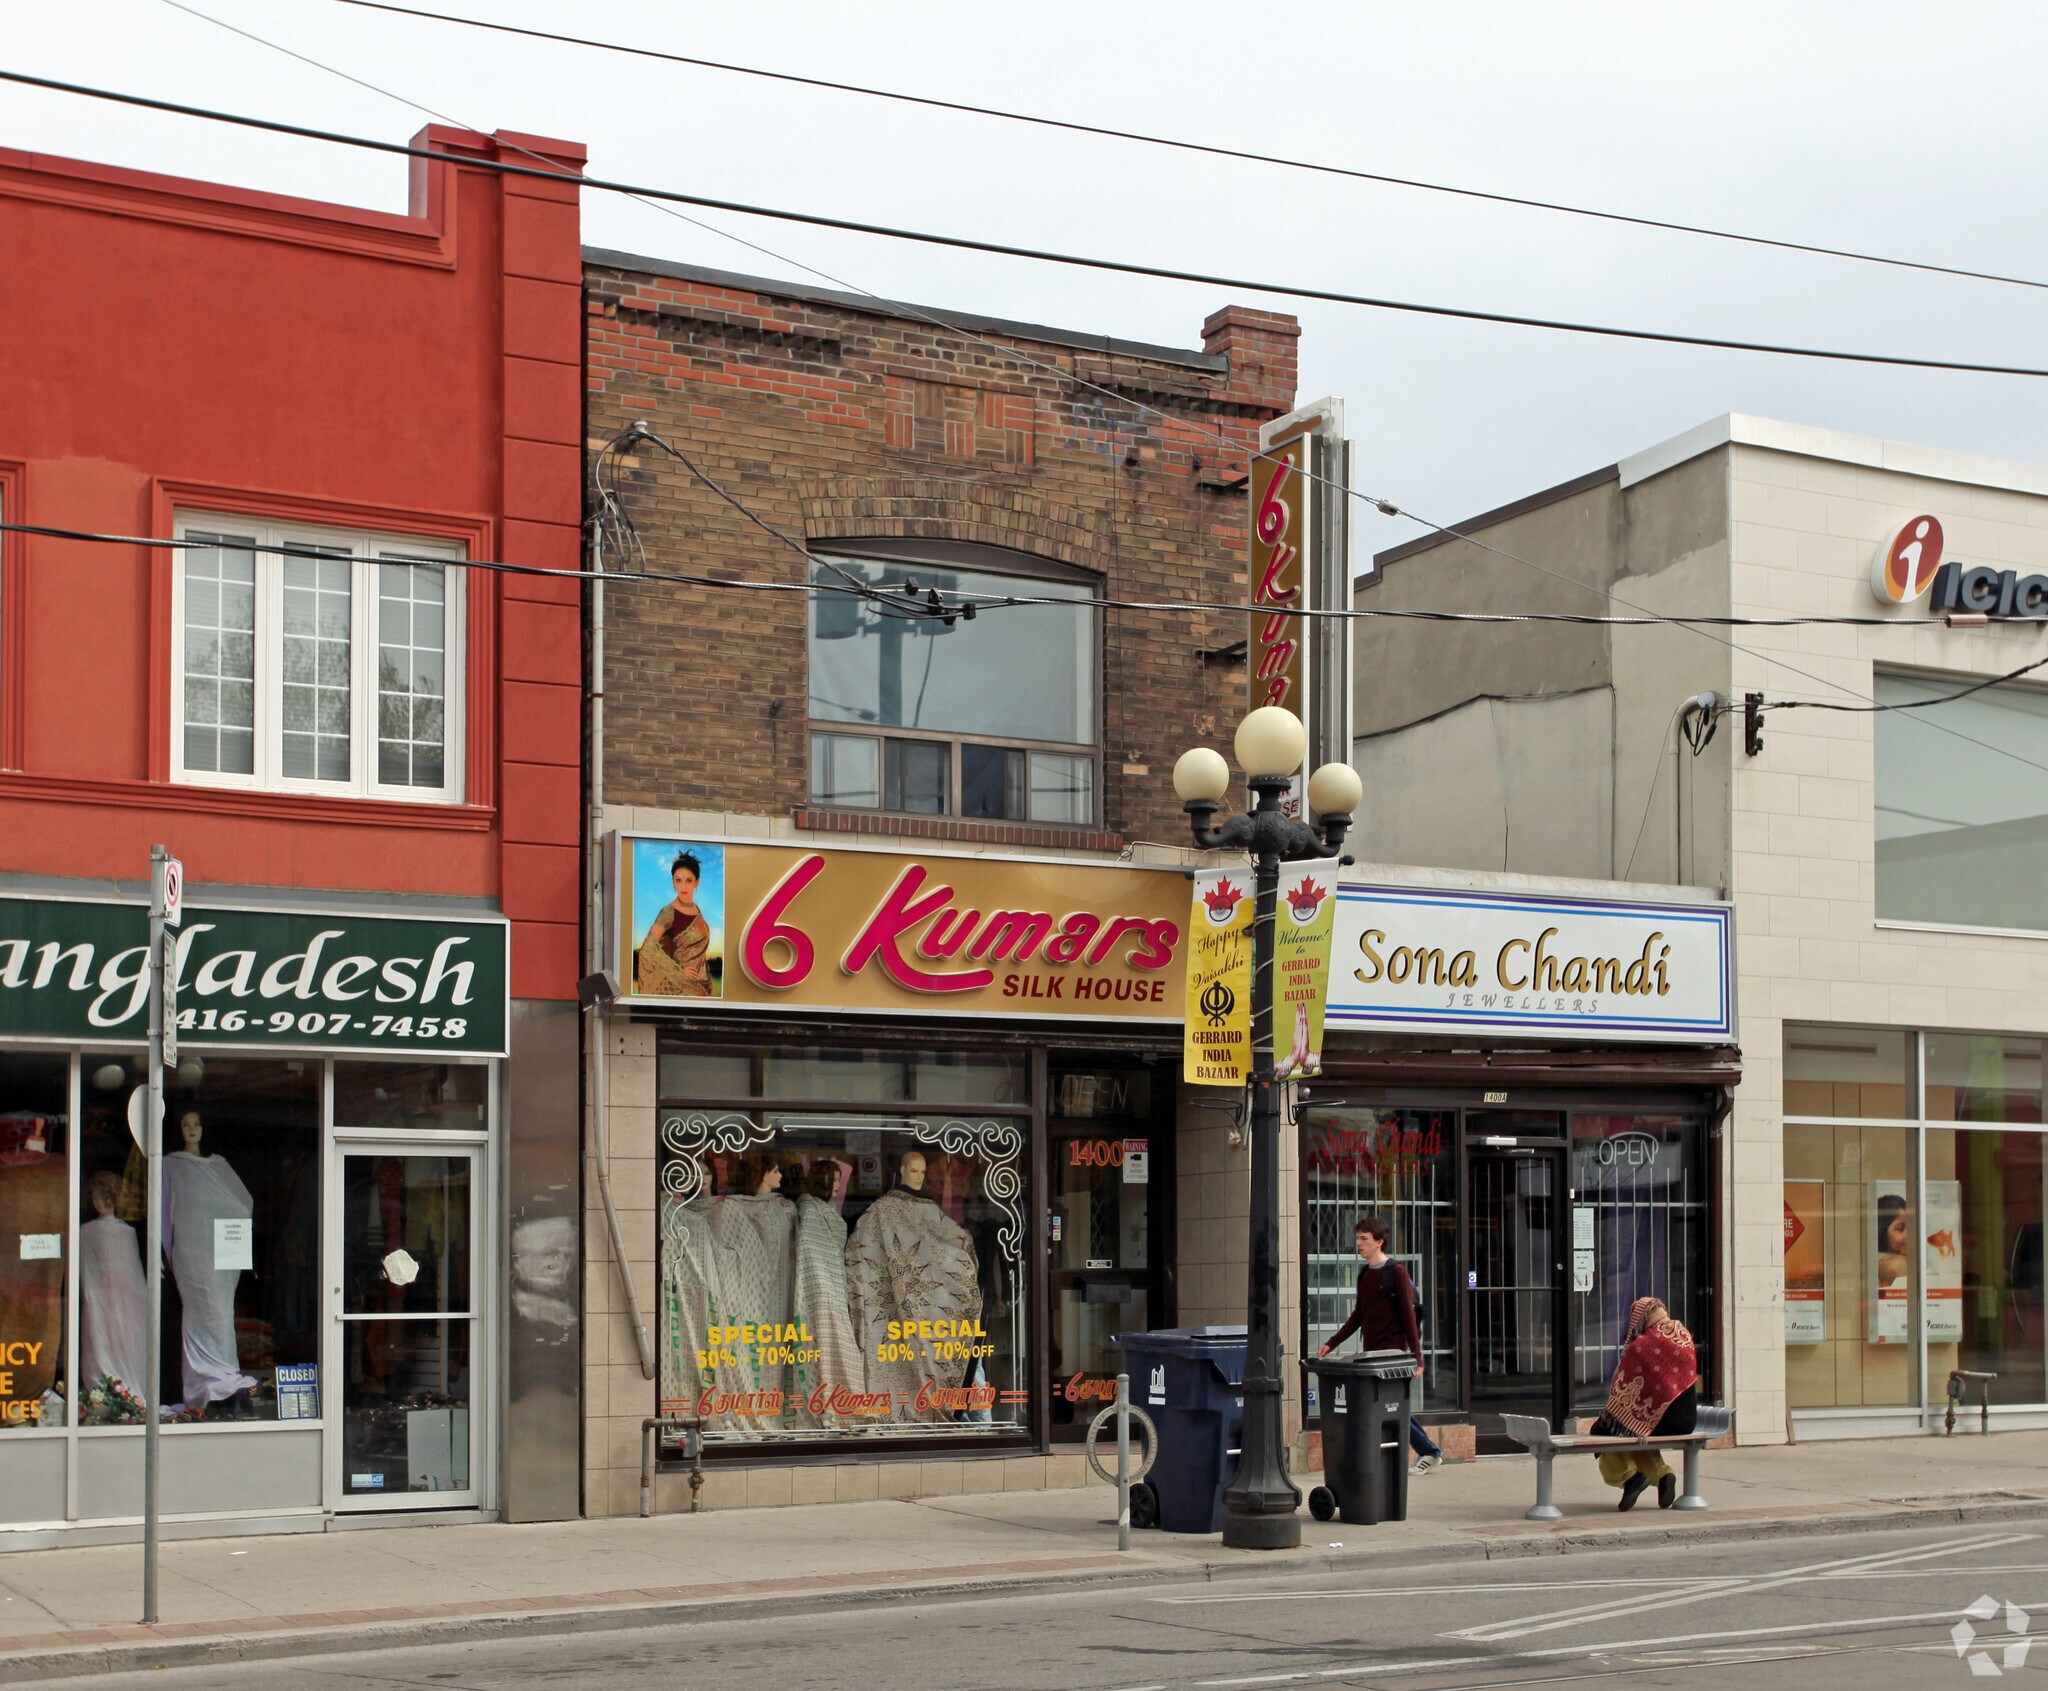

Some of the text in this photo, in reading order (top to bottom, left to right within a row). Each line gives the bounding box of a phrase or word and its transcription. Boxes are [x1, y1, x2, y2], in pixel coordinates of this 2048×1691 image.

[739, 853, 1180, 993] 6 Kumars
[1197, 928, 1240, 957] Happy
[1277, 928, 1330, 946] Welcome!
[1296, 945, 1306, 955] to
[1193, 950, 1246, 990] Vaisakhi
[1281, 957, 1321, 972] GERRARD
[1353, 926, 1672, 997] Sona Chandi
[1002, 974, 1166, 1002] SILK HOUSE
[1289, 974, 1311, 987] INDIA
[1284, 988, 1316, 1002] BAZAAR
[1446, 992, 1599, 1014] JEWELLERS
[176, 1009, 468, 1039] 416-907-7458
[1192, 1030, 1242, 1045] GERRARD
[1202, 1049, 1232, 1062] INDIA
[1196, 1066, 1239, 1080] BAZAAR
[1069, 1140, 1125, 1167] 1400
[1599, 1139, 1655, 1165] OPEN
[707, 1322, 814, 1347] SPECIAL
[886, 1319, 988, 1341] SPECIAL
[696, 1347, 737, 1370] 50%
[756, 1344, 796, 1367] 70%
[797, 1349, 822, 1364] OFF
[876, 1343, 915, 1363] 50%
[933, 1341, 969, 1361] 70%
[971, 1344, 995, 1359] OFF
[279, 1368, 315, 1382] CLOSED
[0, 1400, 42, 1419] ICES
